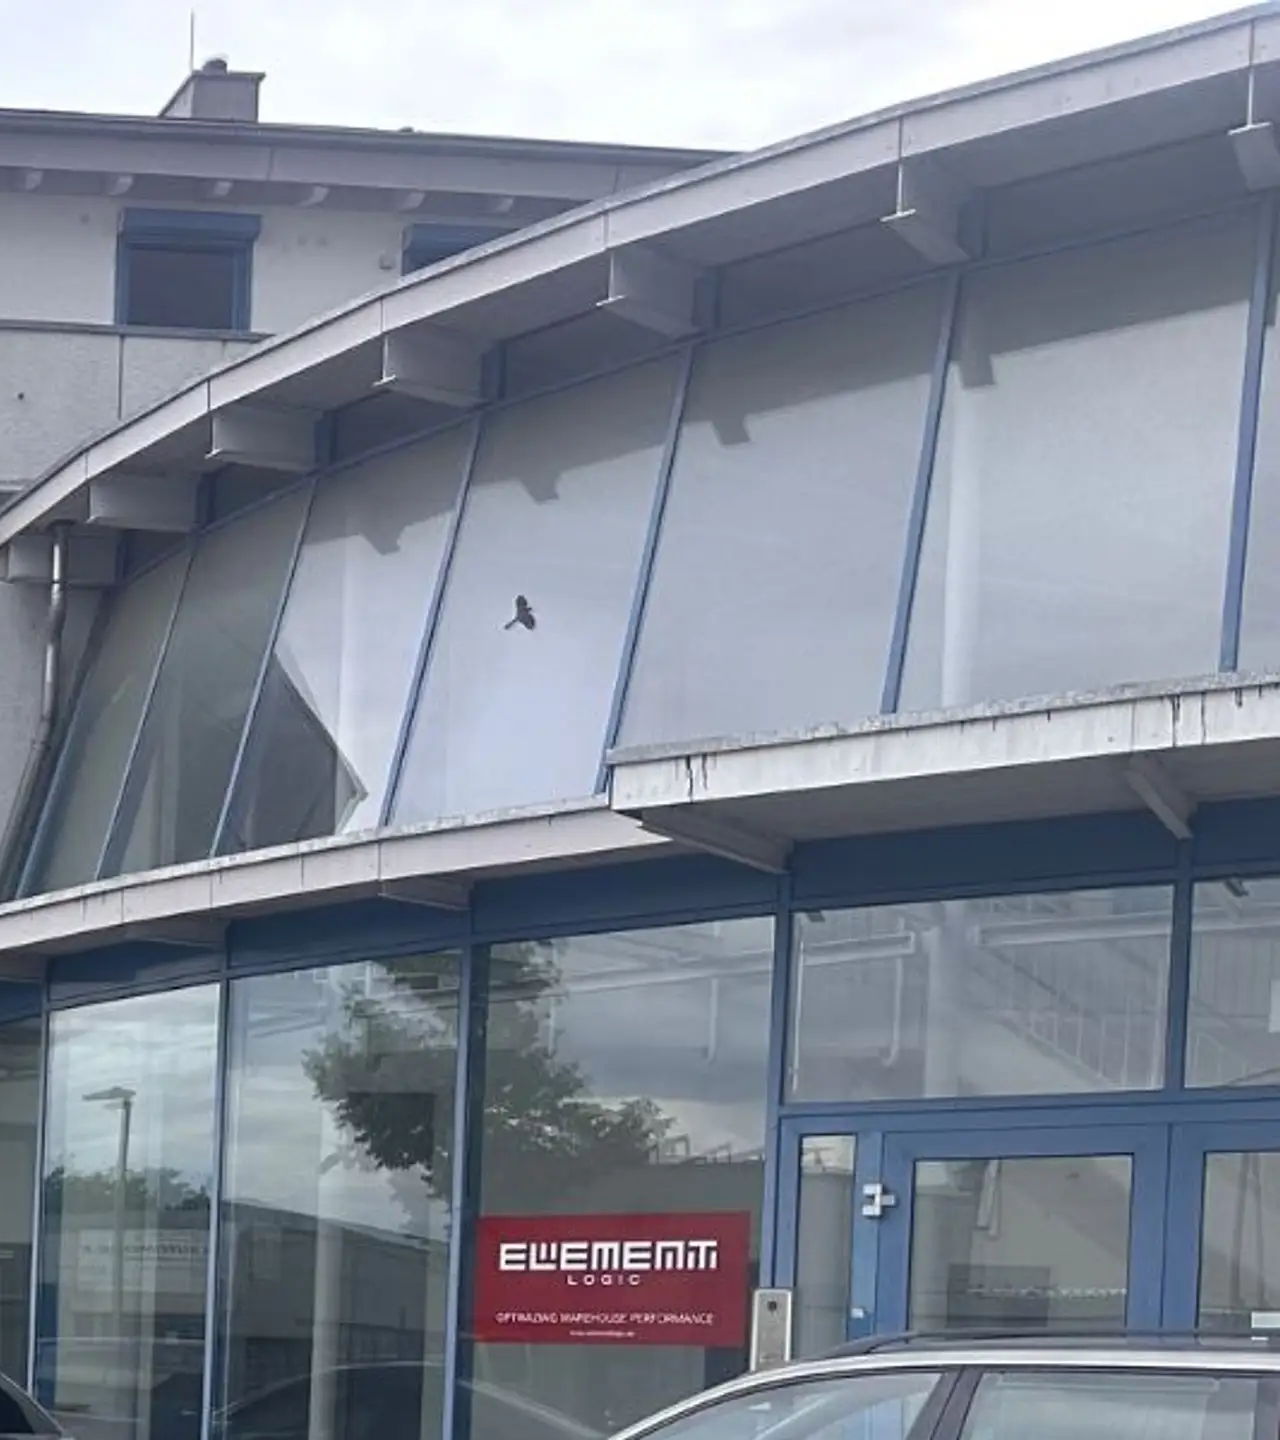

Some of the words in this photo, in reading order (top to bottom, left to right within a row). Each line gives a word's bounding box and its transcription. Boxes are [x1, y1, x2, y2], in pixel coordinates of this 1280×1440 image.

[499, 1240, 718, 1272] ELEMENT
[567, 1274, 641, 1286] LOGIC
[629, 1311, 714, 1326] PERFORMANCE
